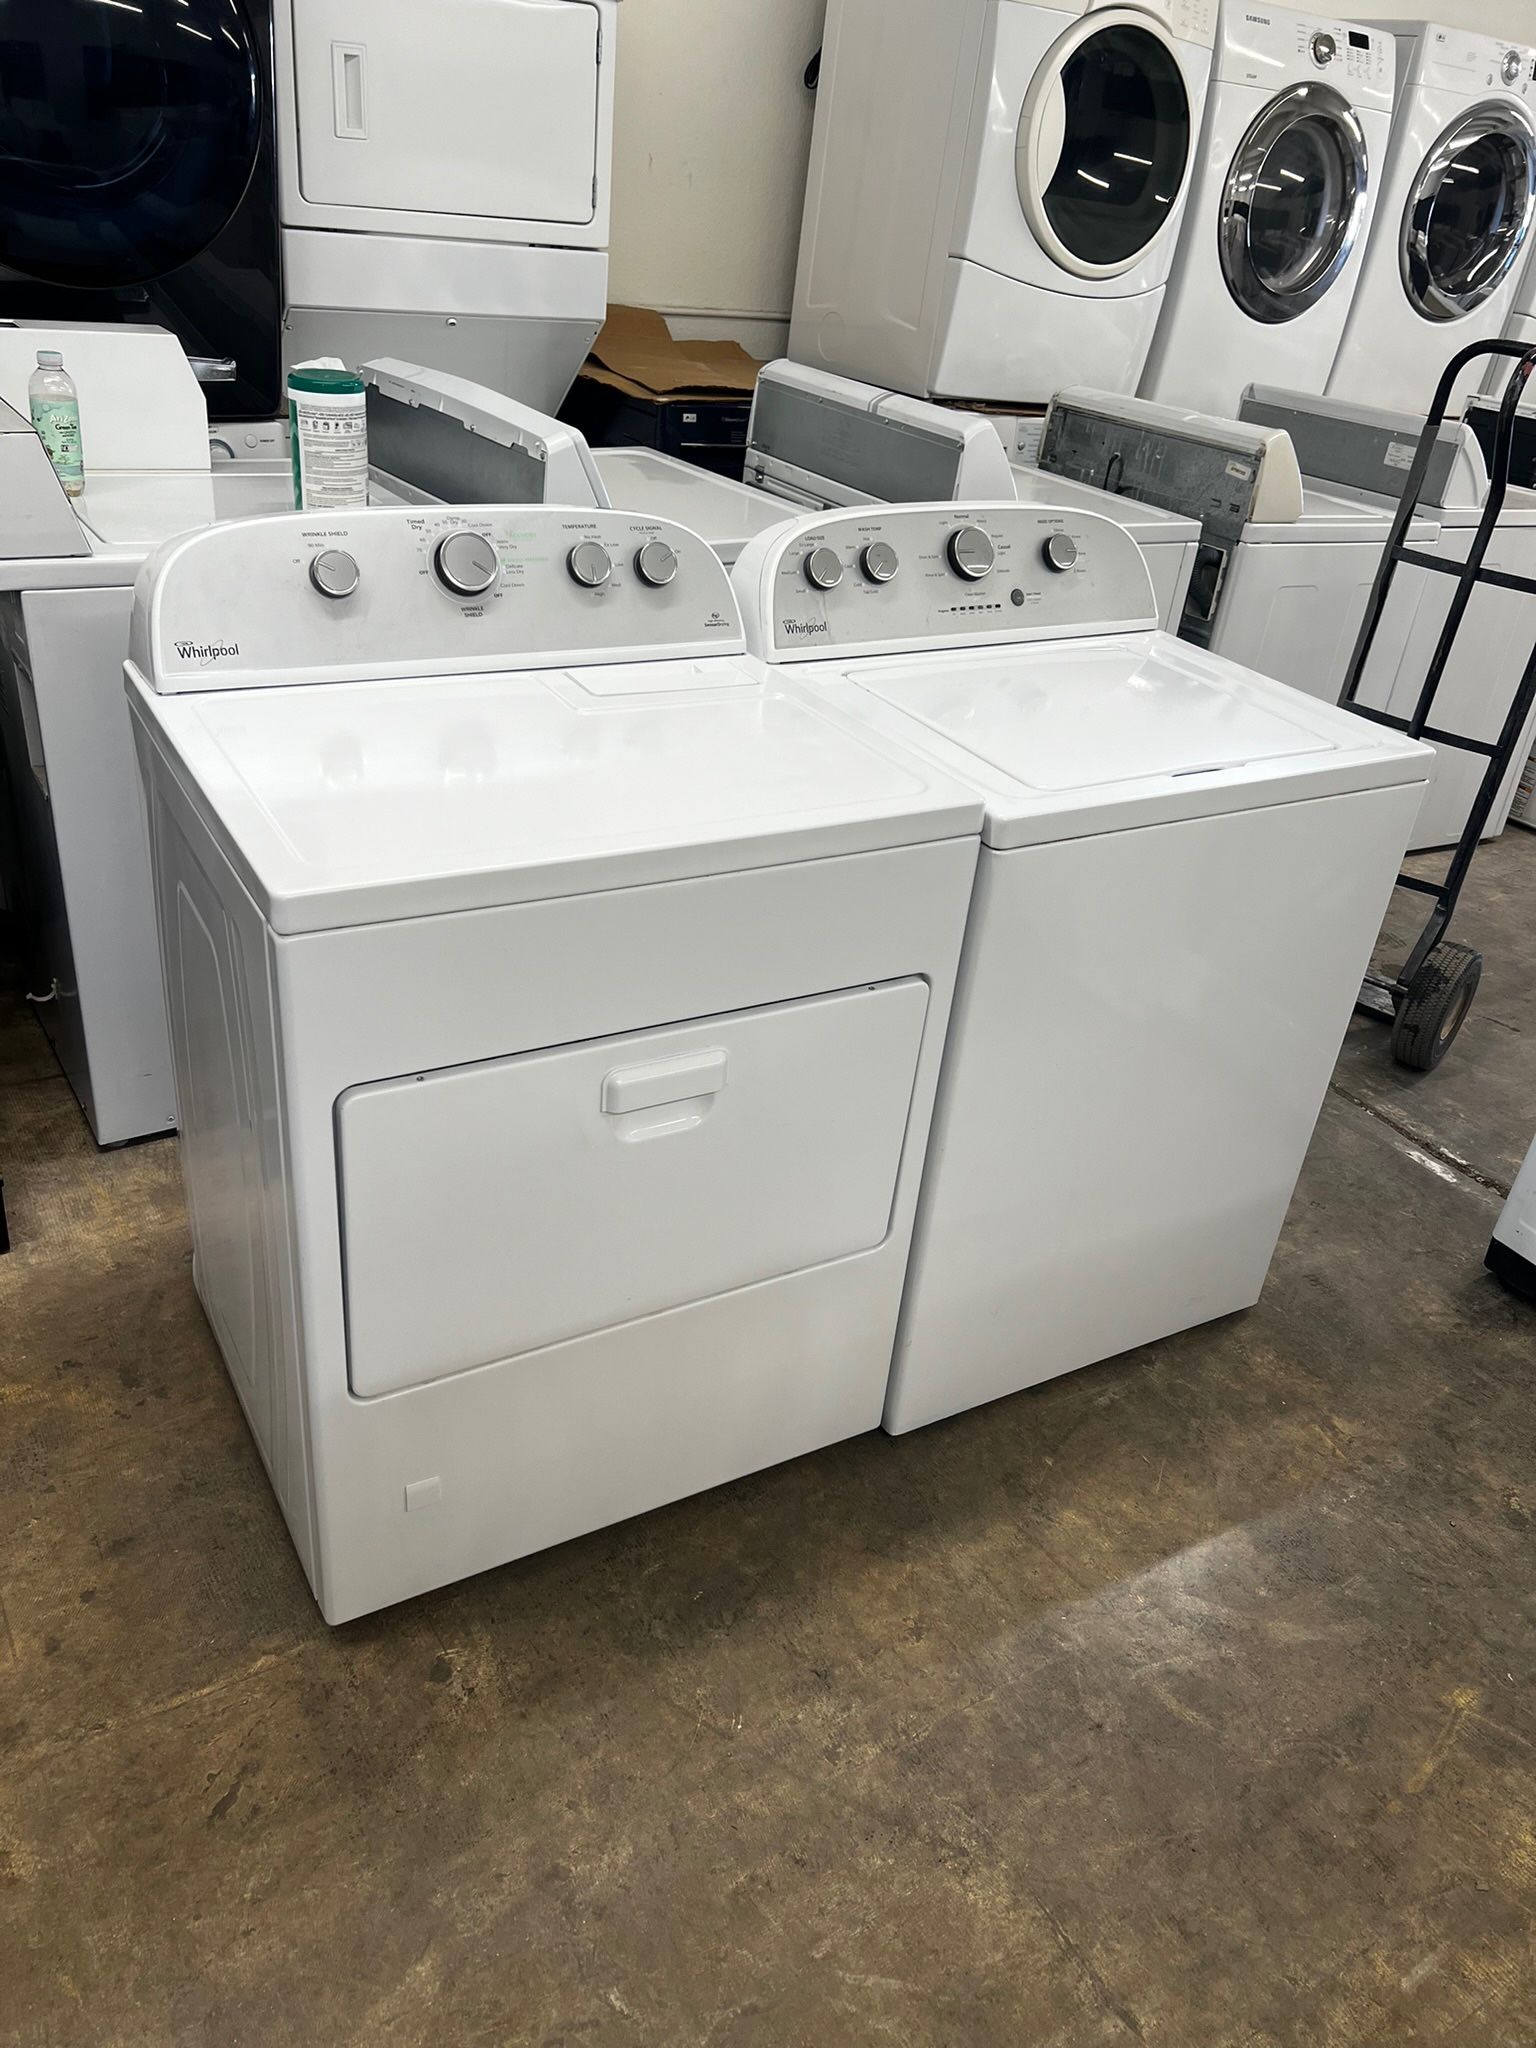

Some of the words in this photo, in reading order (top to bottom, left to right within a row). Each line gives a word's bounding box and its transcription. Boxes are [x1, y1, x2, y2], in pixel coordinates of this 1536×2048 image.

[1245, 14, 1271, 26] SAMSUNG
[784, 621, 827, 635] Whirlpool
[177, 643, 239, 660] Whirlpool
